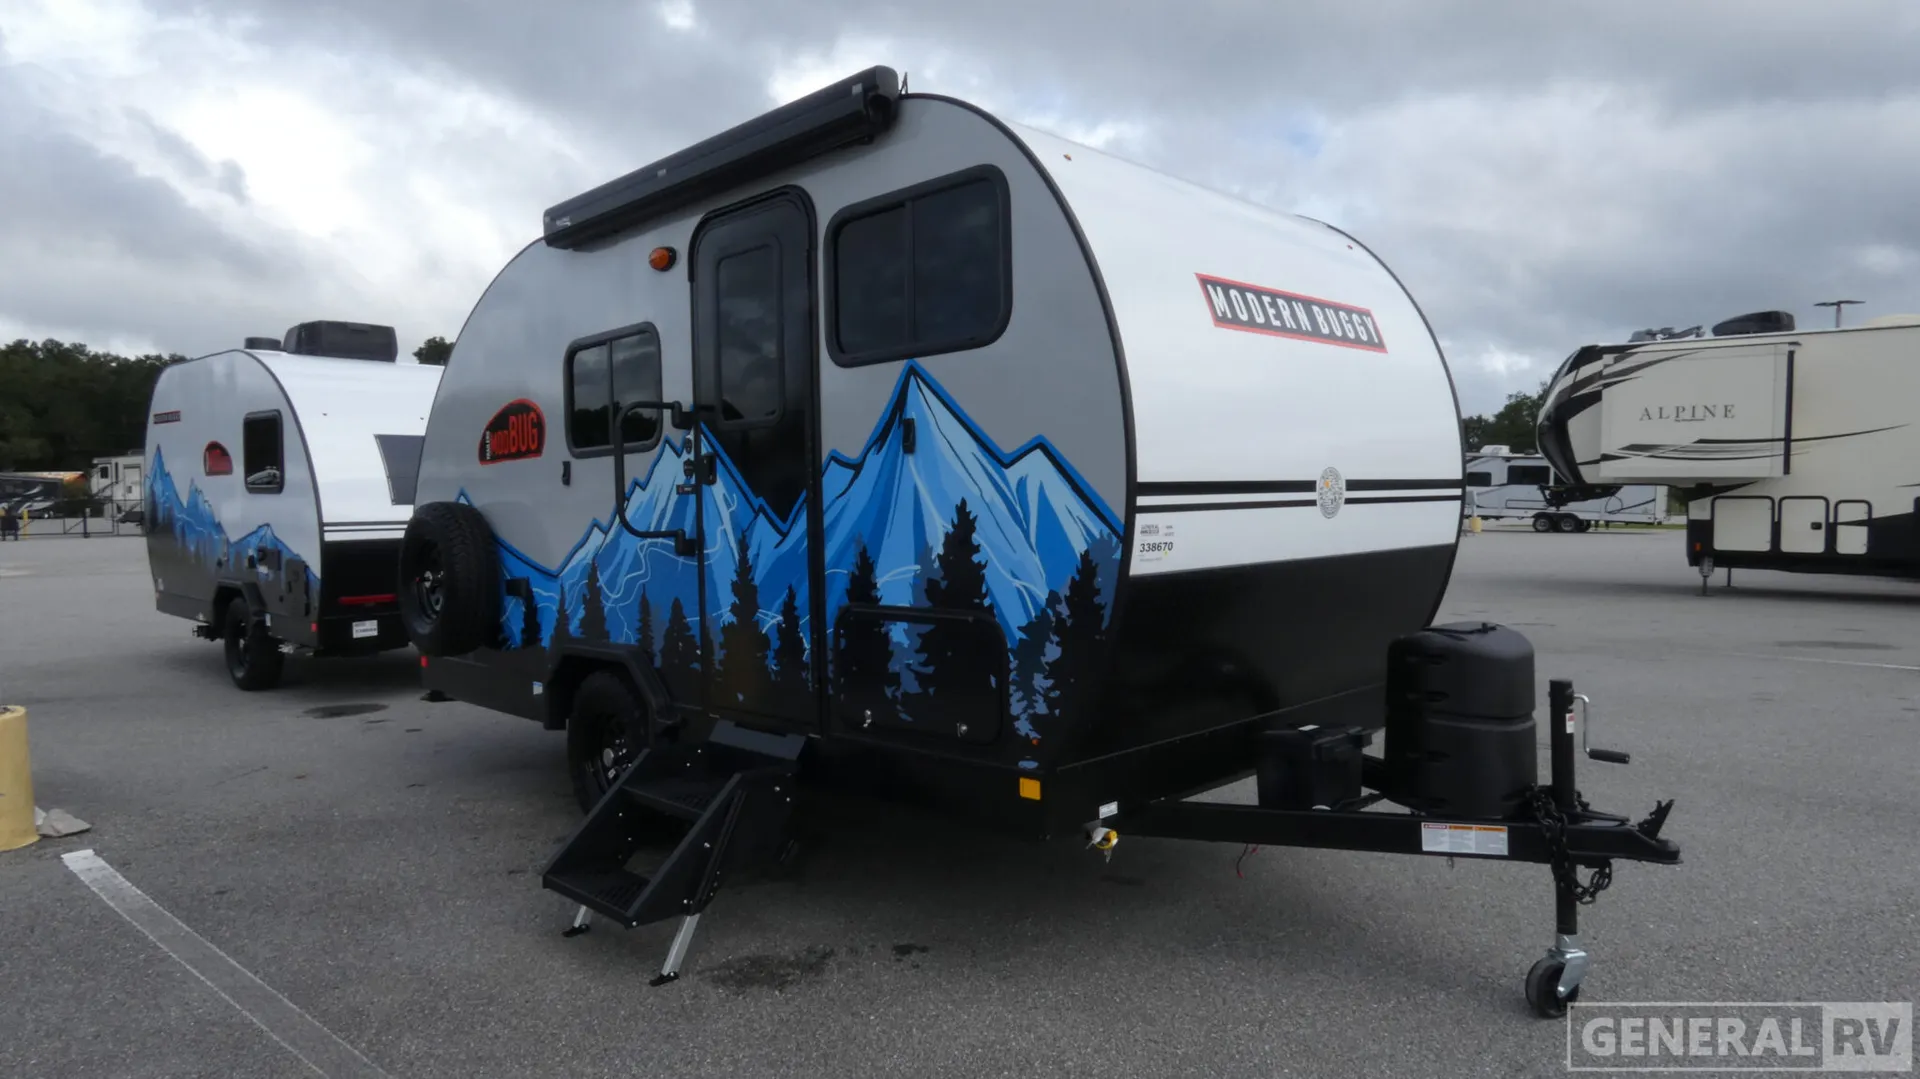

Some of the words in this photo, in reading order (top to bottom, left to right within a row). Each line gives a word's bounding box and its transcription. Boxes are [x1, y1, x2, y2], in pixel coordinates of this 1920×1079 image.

[1207, 284, 1312, 332] MODERN
[1312, 305, 1379, 343] BUGGY
[1639, 404, 1736, 421] ALPINE
[1140, 541, 1174, 553] 338670
